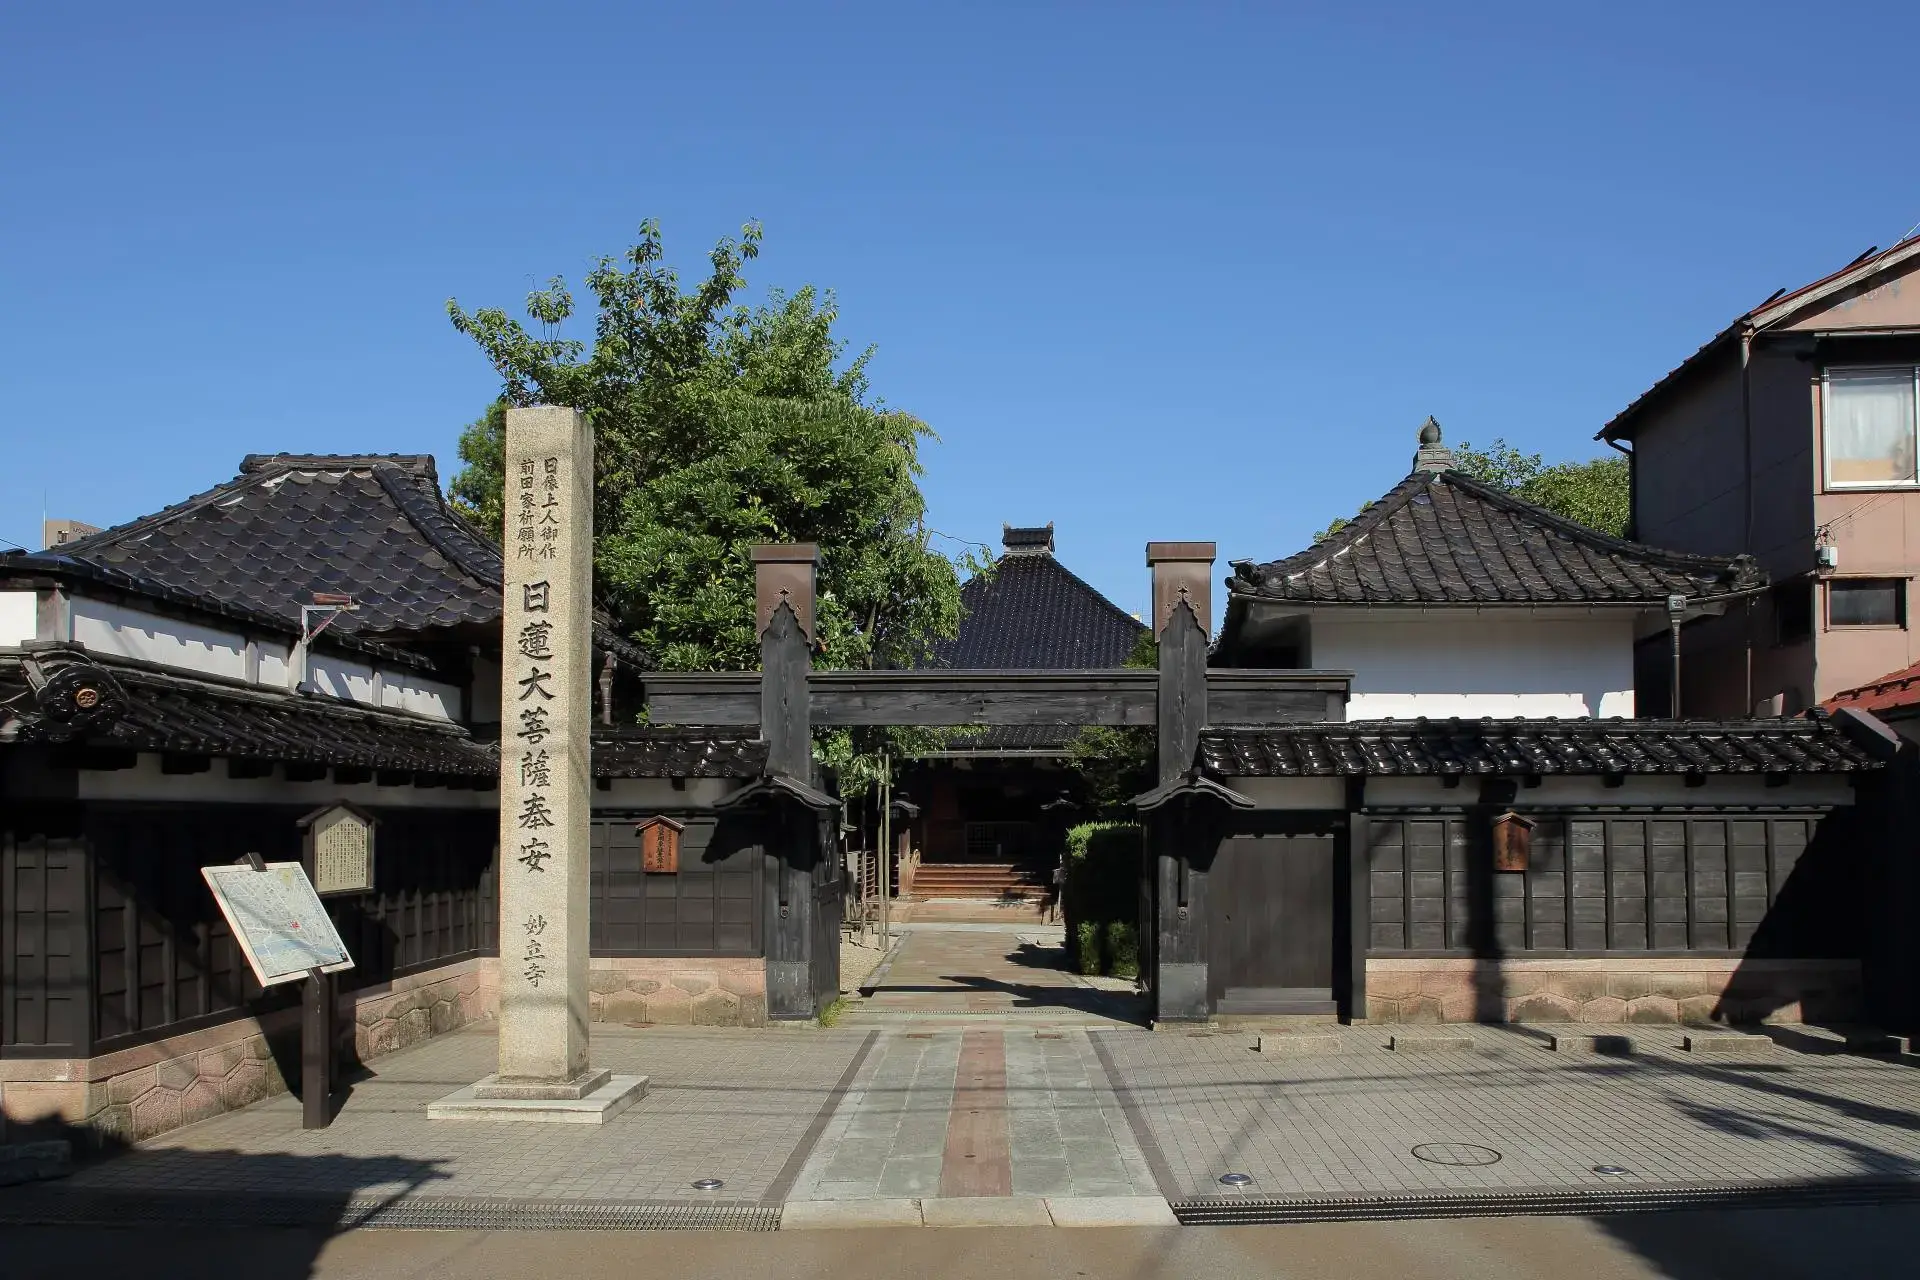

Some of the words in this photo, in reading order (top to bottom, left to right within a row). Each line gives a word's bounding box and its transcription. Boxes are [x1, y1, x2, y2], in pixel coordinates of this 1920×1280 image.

[518, 459, 536, 560] 前田家祈願所
[517, 580, 556, 874] 日蓮大菩薩奉安
[522, 914, 548, 988] 妙立寺
